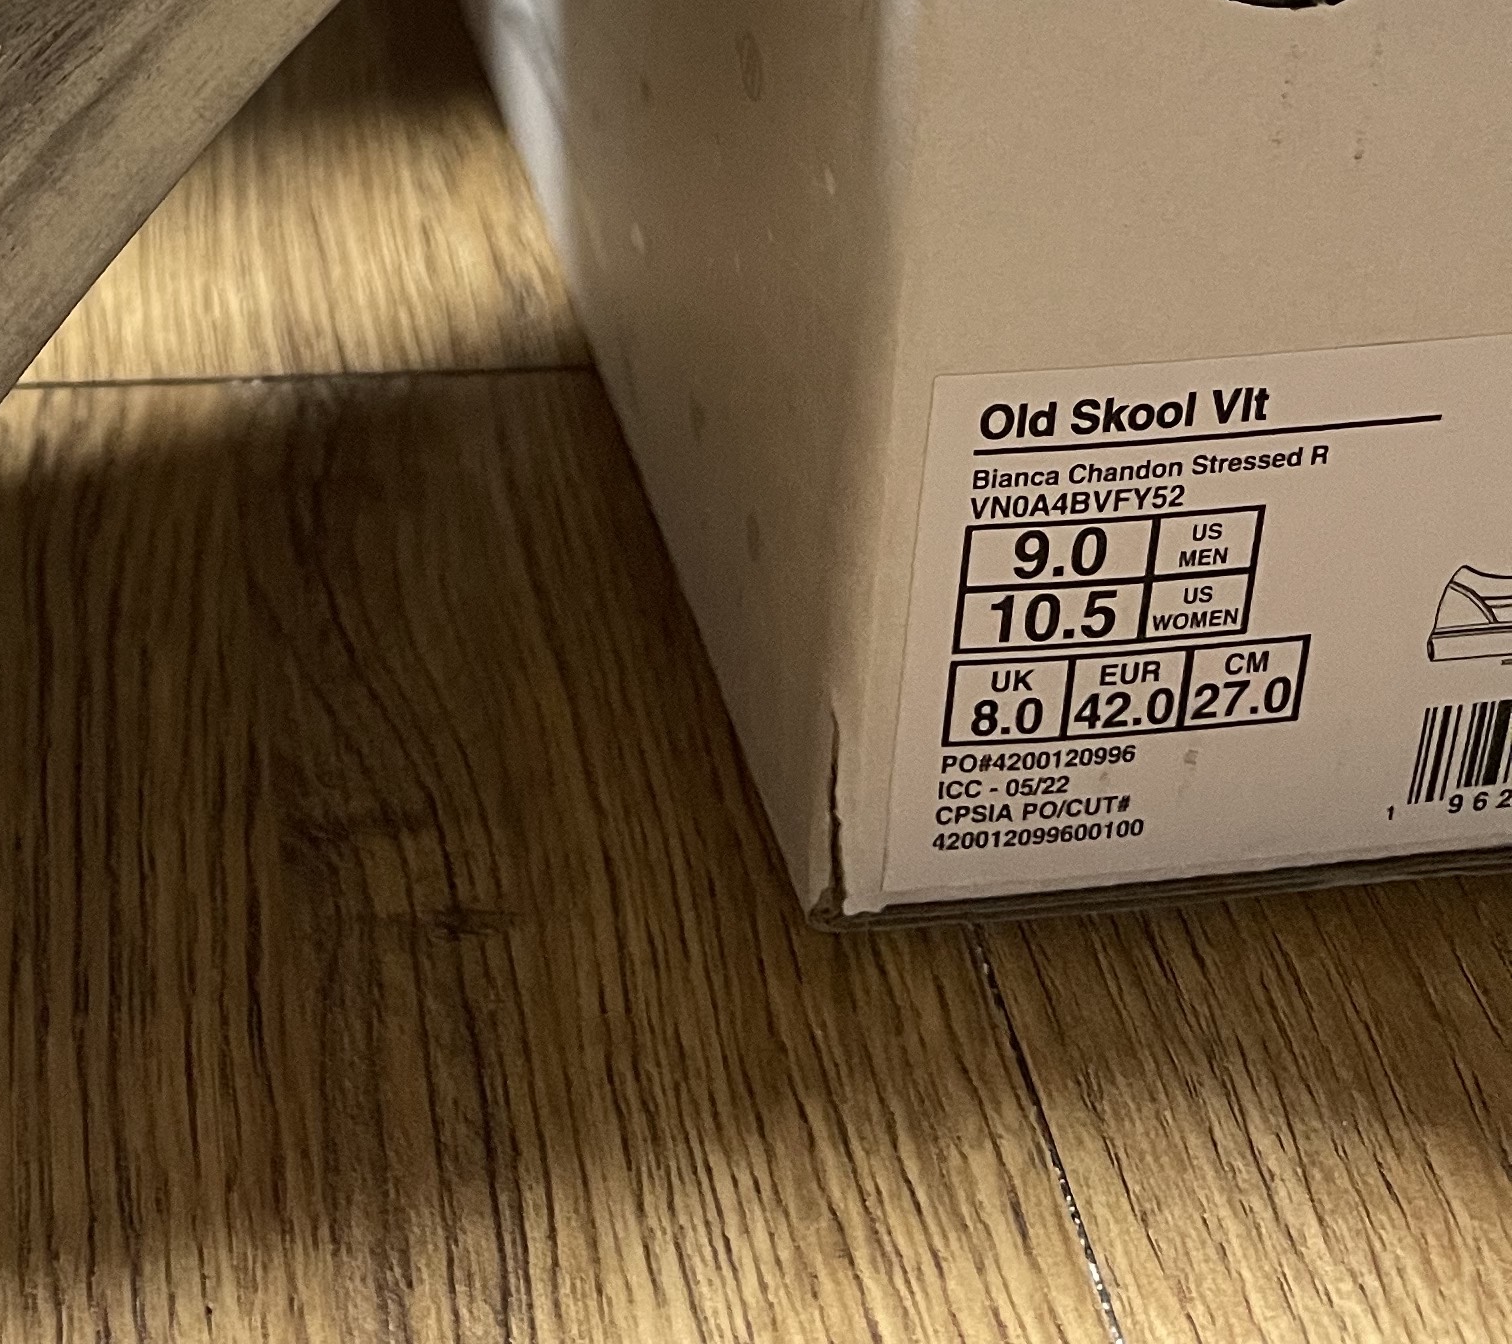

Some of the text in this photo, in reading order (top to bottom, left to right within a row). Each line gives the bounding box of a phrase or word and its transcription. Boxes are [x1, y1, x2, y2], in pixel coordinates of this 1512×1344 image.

[979, 401, 1058, 440] Old
[1070, 392, 1198, 436] Skool
[972, 444, 1330, 490] Bianca Chandon Stressed R
[970, 485, 1186, 520] VN0A4BVFY52
[1192, 522, 1223, 542] US
[1010, 525, 1108, 579] 9.0
[1178, 546, 1229, 568] MEN
[1183, 585, 1213, 605] US
[988, 587, 1120, 644] 10.5
[1152, 607, 1240, 633] WOMEN
[1099, 660, 1161, 687] EUR
[1224, 650, 1270, 676] CM
[990, 668, 1035, 693] UK
[1073, 687, 1176, 732] 42.0
[1190, 675, 1291, 721] 27.0
[970, 697, 1044, 737] 8.0
[940, 743, 1137, 774] PO#4200120996
[938, 779, 983, 800] ICC
[1005, 775, 1070, 798] 05/22
[935, 794, 1131, 826] CPSIA PO/CUT#
[932, 817, 1145, 851] 420012099600100
